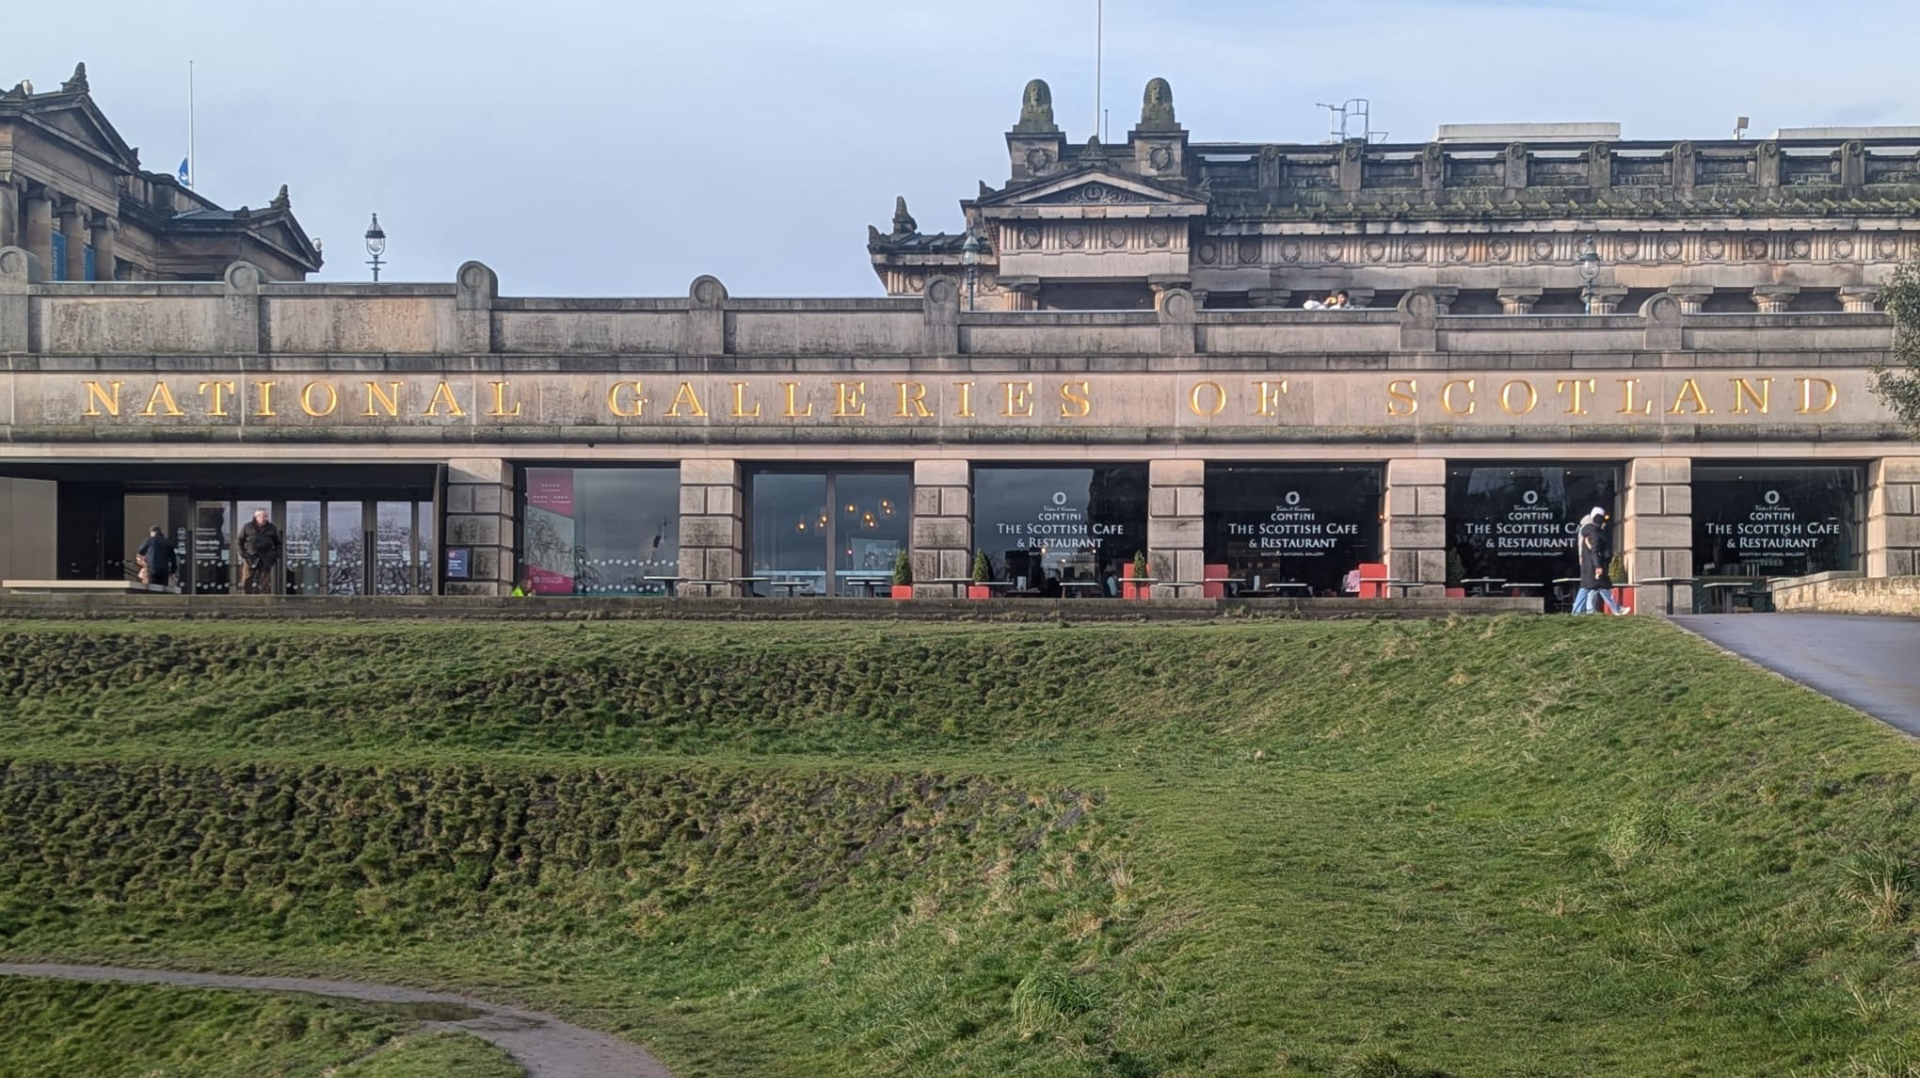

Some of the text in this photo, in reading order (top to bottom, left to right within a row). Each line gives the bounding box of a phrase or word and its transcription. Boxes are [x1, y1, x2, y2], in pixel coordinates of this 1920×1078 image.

[81, 378, 1841, 419] NATIONAL GALLERIES OF SCOTLAND
[1038, 513, 1082, 521] CONTINI
[1270, 512, 1316, 522] CONTINI
[1508, 512, 1554, 521] CONTINI
[1749, 512, 1795, 521] CONTINI
[1017, 539, 1025, 548] &
[1249, 539, 1258, 548] &
[1486, 539, 1495, 548] &
[1727, 539, 1736, 549] &
